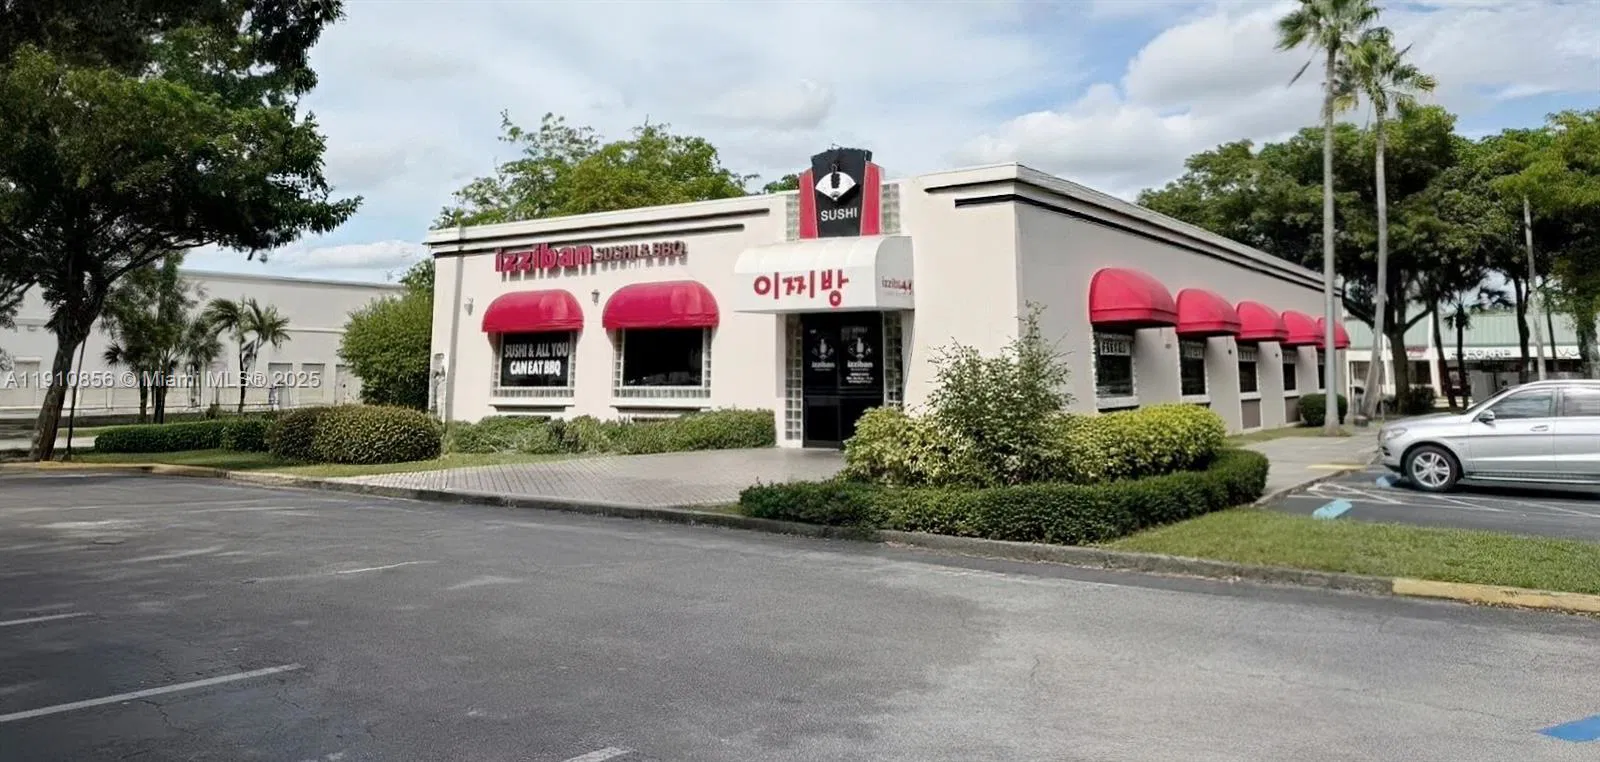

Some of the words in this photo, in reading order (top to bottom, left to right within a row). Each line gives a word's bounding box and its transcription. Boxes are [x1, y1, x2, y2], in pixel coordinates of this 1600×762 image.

[820, 207, 858, 222] SUSHI
[494, 242, 594, 273] izziban
[594, 245, 637, 262] SUSHI
[637, 243, 650, 258] &
[651, 240, 688, 257] BBQ
[753, 269, 849, 307] 이찌방
[504, 343, 528, 359] SUSHI
[528, 343, 535, 358] &
[535, 343, 551, 358] ALL
[551, 342, 569, 358] YOU
[510, 360, 528, 376] CAN
[528, 359, 544, 376] EAT
[544, 359, 561, 377] BBQ
